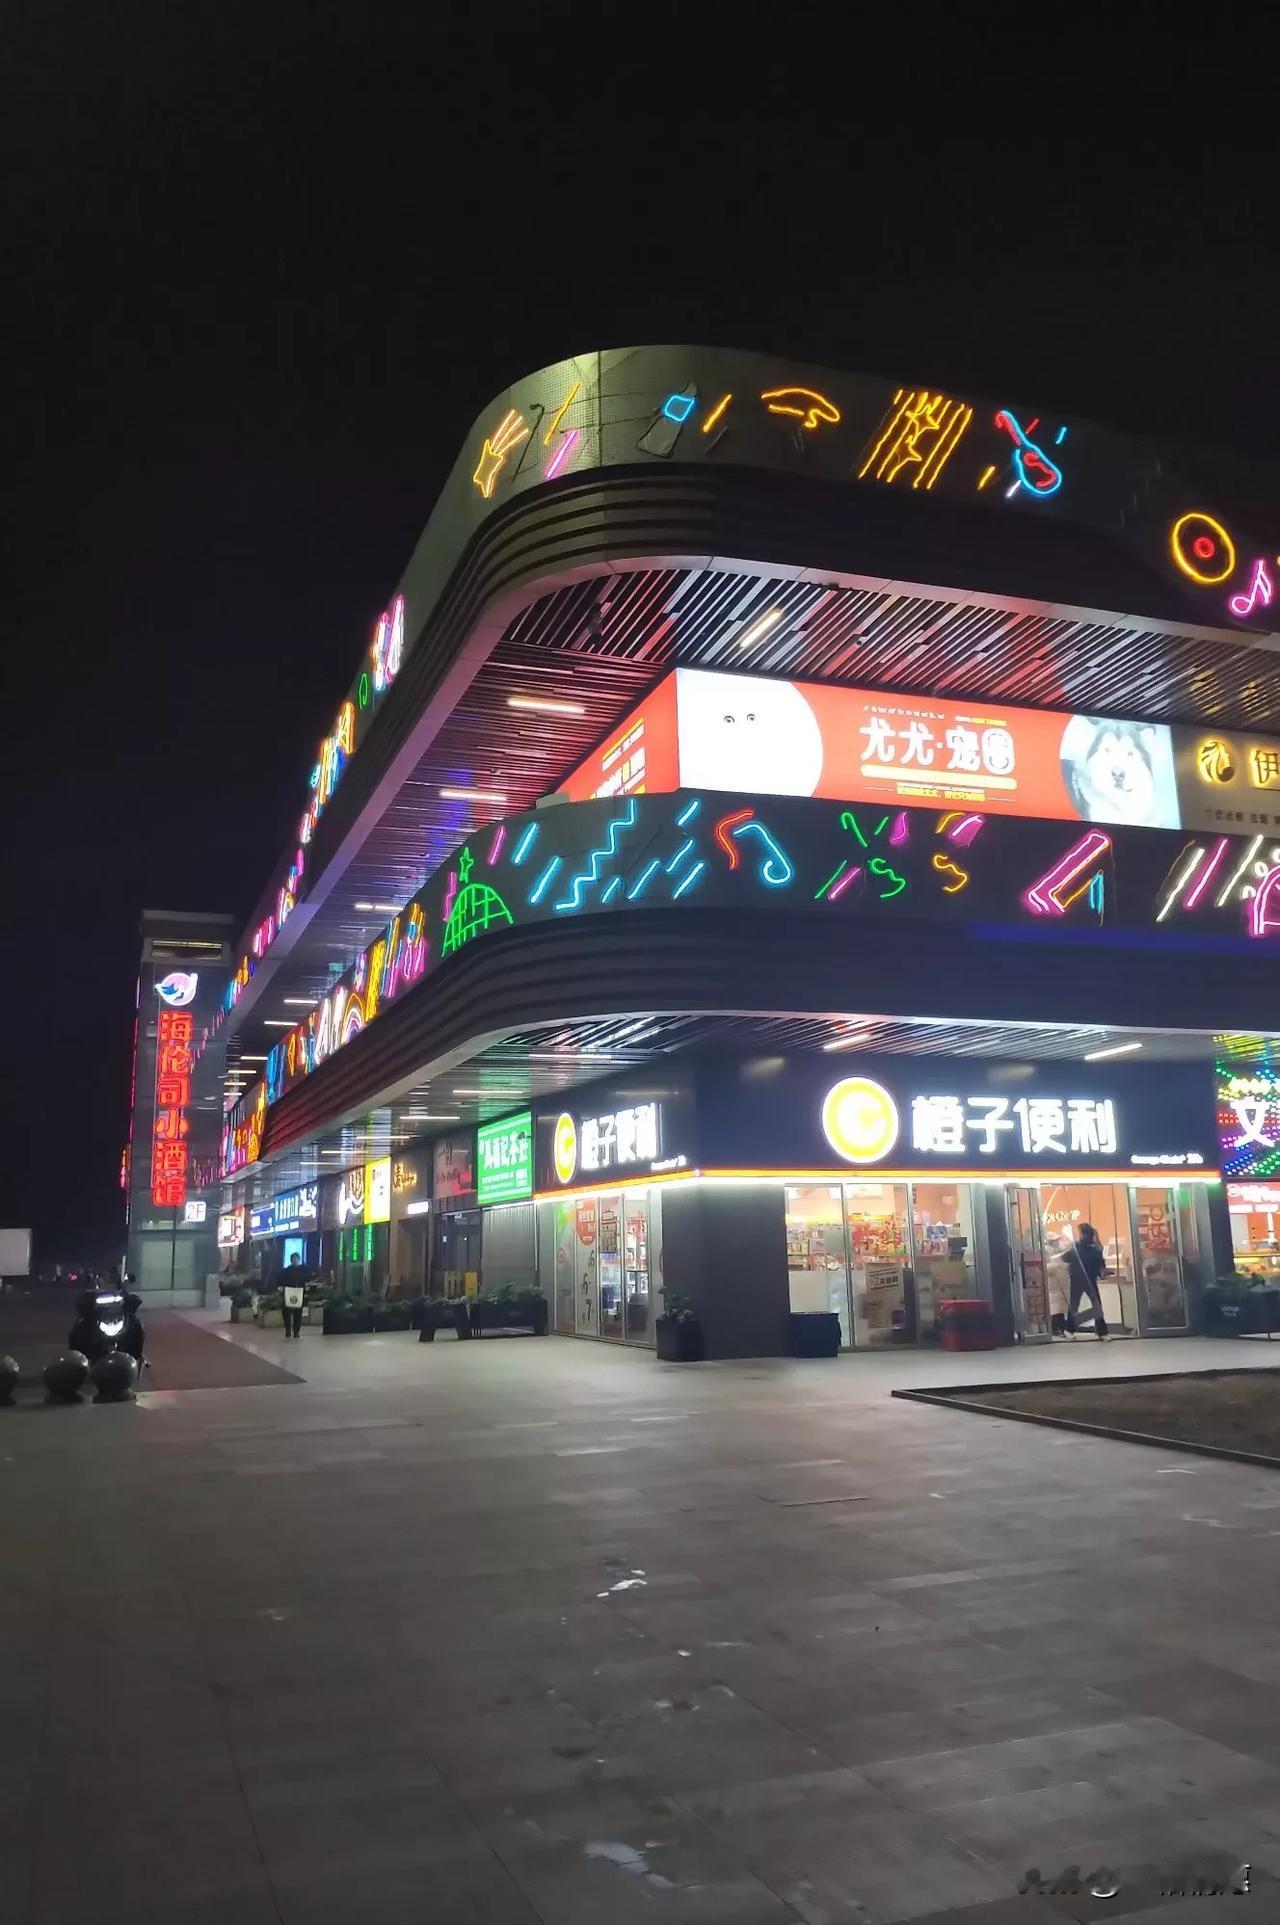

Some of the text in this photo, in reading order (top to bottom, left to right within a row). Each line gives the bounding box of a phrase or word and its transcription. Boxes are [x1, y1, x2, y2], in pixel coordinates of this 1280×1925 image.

[154, 1010, 193, 1206] 海伦司小酒馆
[911, 1096, 1118, 1153] 橙子便利
[187, 1203, 205, 1219] 2F
